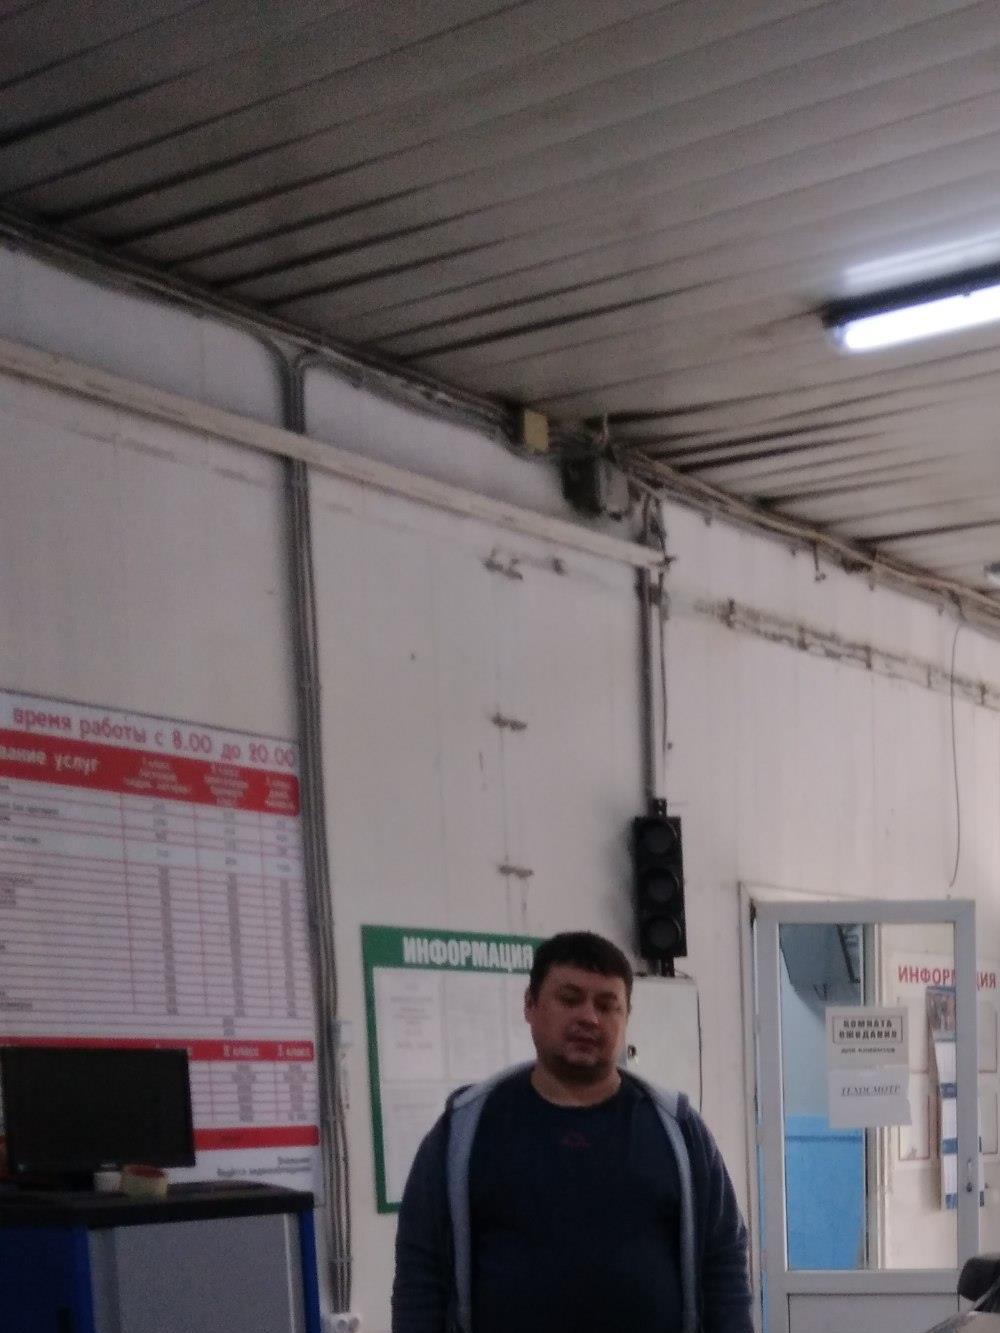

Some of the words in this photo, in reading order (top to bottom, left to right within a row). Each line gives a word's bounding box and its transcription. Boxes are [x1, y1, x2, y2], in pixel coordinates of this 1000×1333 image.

[79, 717, 146, 744] работы
[403, 936, 534, 969] ИНФОРМАЦИЯ
[898, 965, 997, 991] ИНФОРИЯ
[843, 1019, 893, 1029] КОМНАТА
